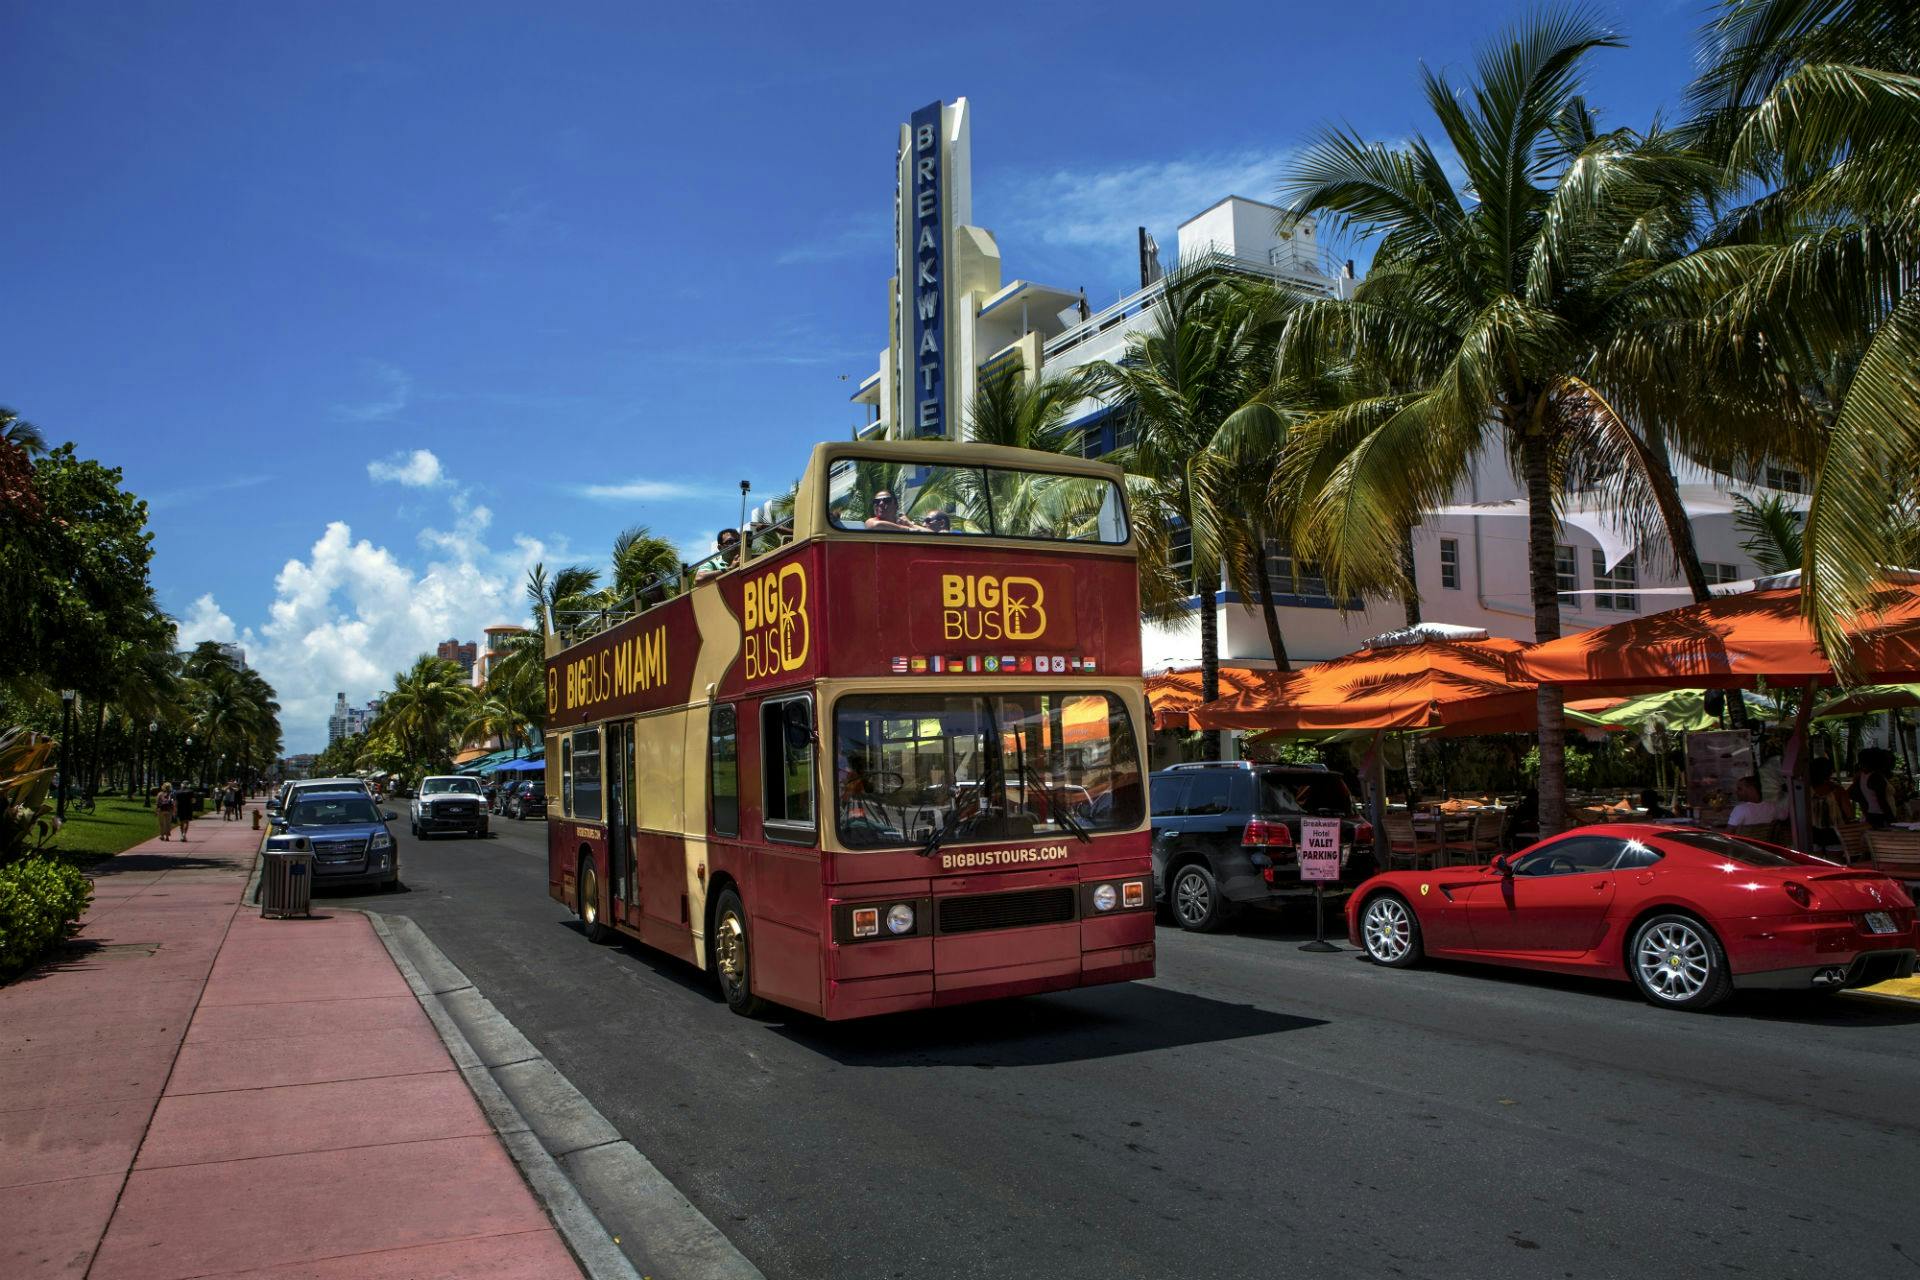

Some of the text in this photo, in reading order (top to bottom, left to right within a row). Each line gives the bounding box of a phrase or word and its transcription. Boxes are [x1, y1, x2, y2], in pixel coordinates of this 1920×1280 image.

[917, 123, 939, 428] BREAKWATE
[744, 572, 778, 632] BIG
[942, 575, 1000, 608] BIG
[944, 610, 1001, 640] BUS
[614, 625, 667, 698] MIAMI
[745, 628, 780, 680] BUS
[1308, 838, 1334, 848] VALET
[1312, 829, 1330, 837] Hotel
[942, 846, 1068, 868] BIGBUSTOURS.COM
[1302, 850, 1338, 860] PARKING
